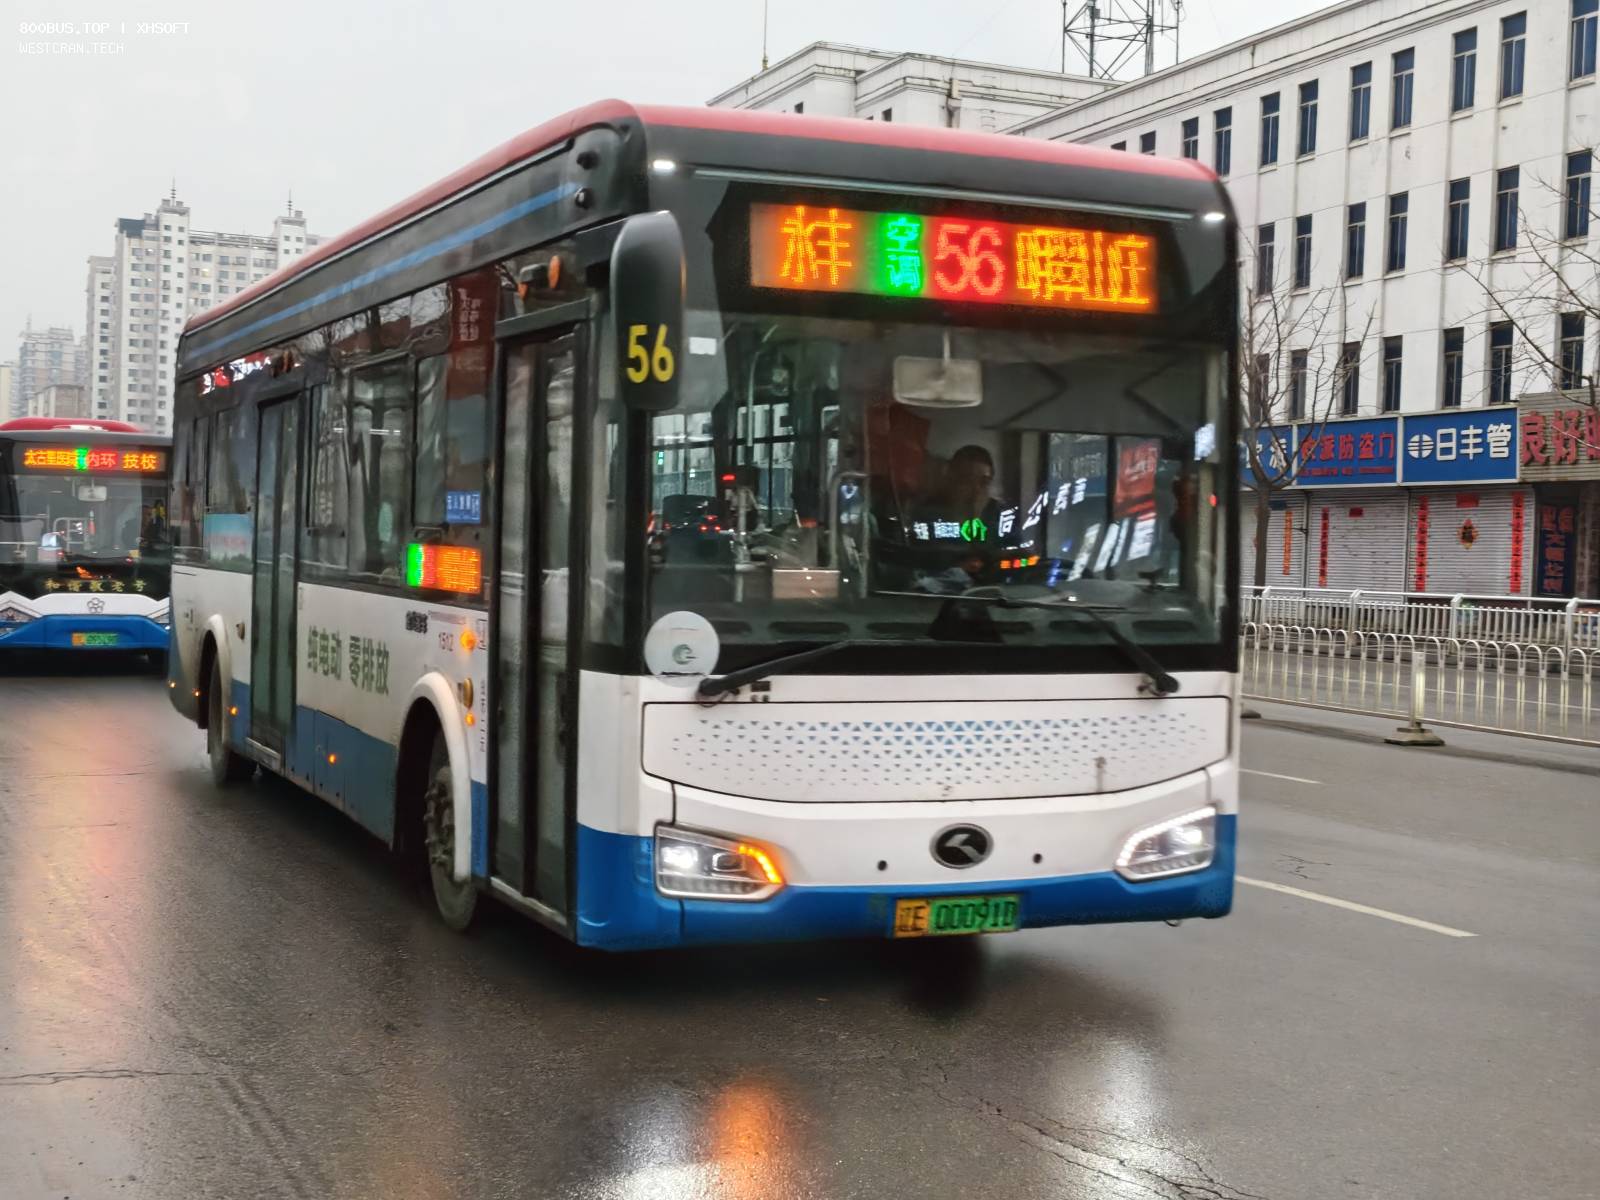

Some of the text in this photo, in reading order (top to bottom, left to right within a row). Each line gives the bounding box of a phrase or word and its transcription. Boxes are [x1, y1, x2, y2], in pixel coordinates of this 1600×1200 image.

[884, 216, 921, 291] 空调
[933, 222, 1005, 297] 56
[626, 323, 675, 384] 56
[87, 452, 116, 469] 内环
[123, 452, 157, 471] 技校
[1436, 423, 1512, 461] 日丰管
[349, 634, 389, 697] 零排放
